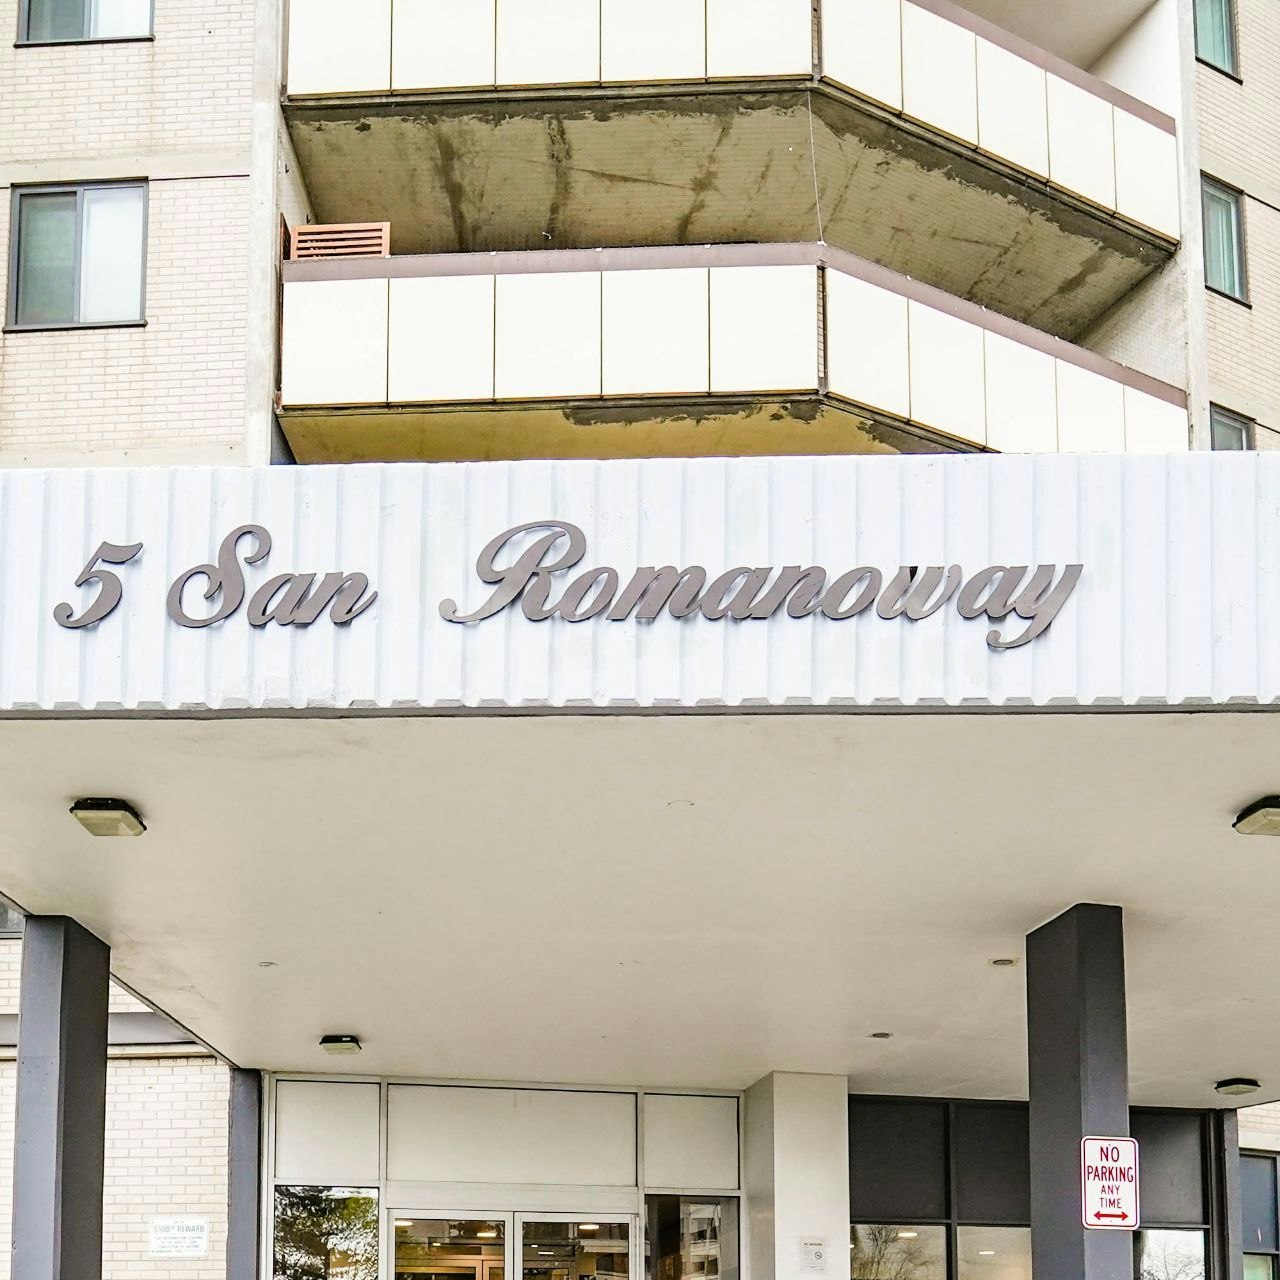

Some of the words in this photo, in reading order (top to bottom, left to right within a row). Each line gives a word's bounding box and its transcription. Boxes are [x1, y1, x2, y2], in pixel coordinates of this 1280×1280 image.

[53, 541, 143, 629] 5
[165, 524, 378, 629] San
[438, 519, 1084, 651] Romanoway
[1100, 1146, 1120, 1162] NO
[1087, 1165, 1133, 1183] PARKING
[1100, 1184, 1121, 1195] ANY
[1099, 1197, 1122, 1209] TIME
